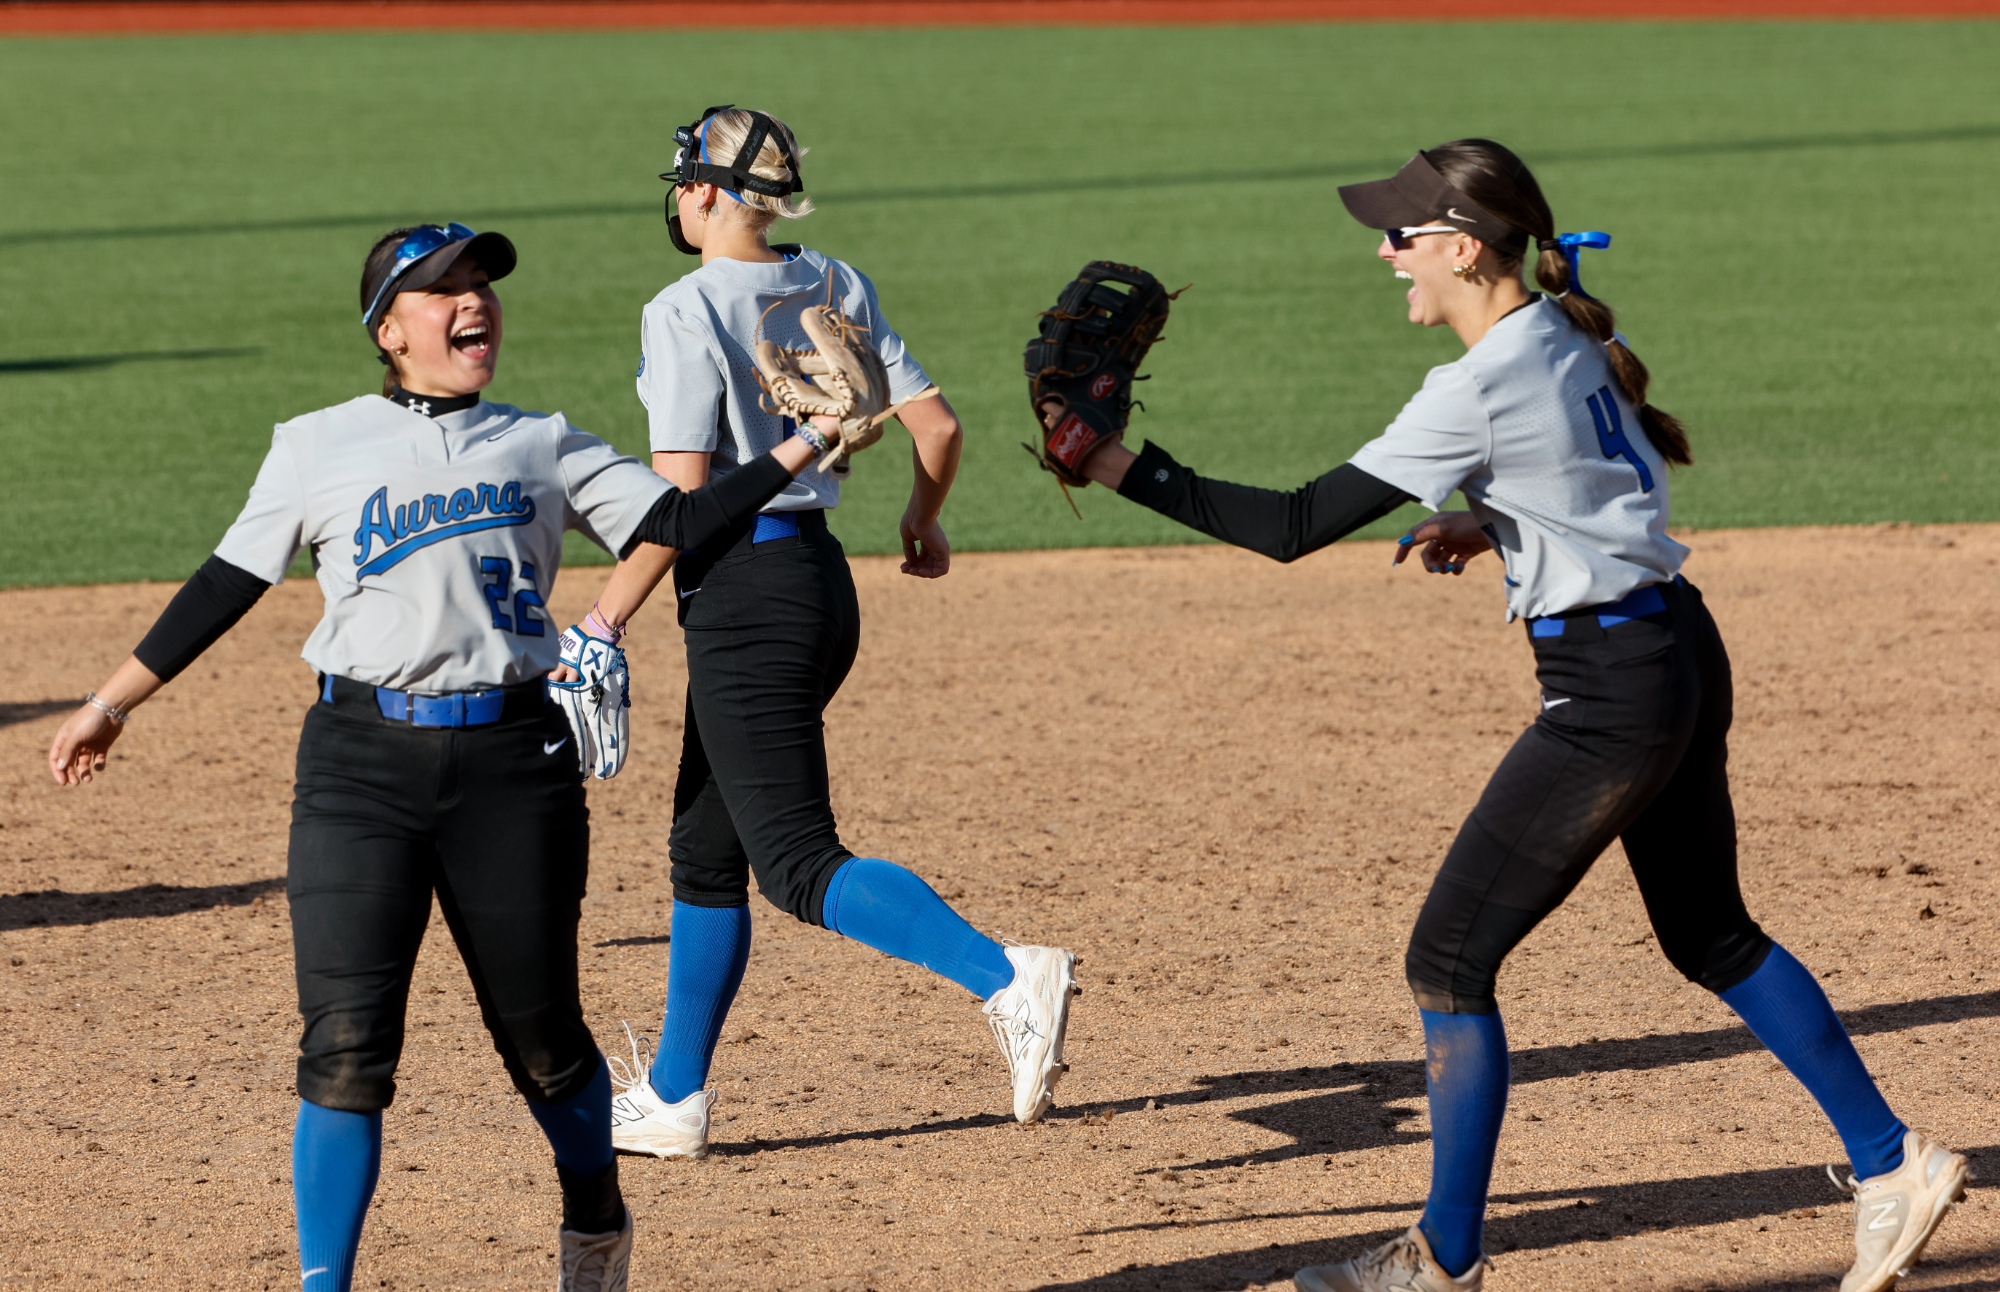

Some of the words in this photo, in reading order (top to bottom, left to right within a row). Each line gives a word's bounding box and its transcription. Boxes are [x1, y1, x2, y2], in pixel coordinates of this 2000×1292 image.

[1585, 385, 1655, 494] 4
[353, 480, 536, 567] Aurora
[480, 556, 547, 638] 22
